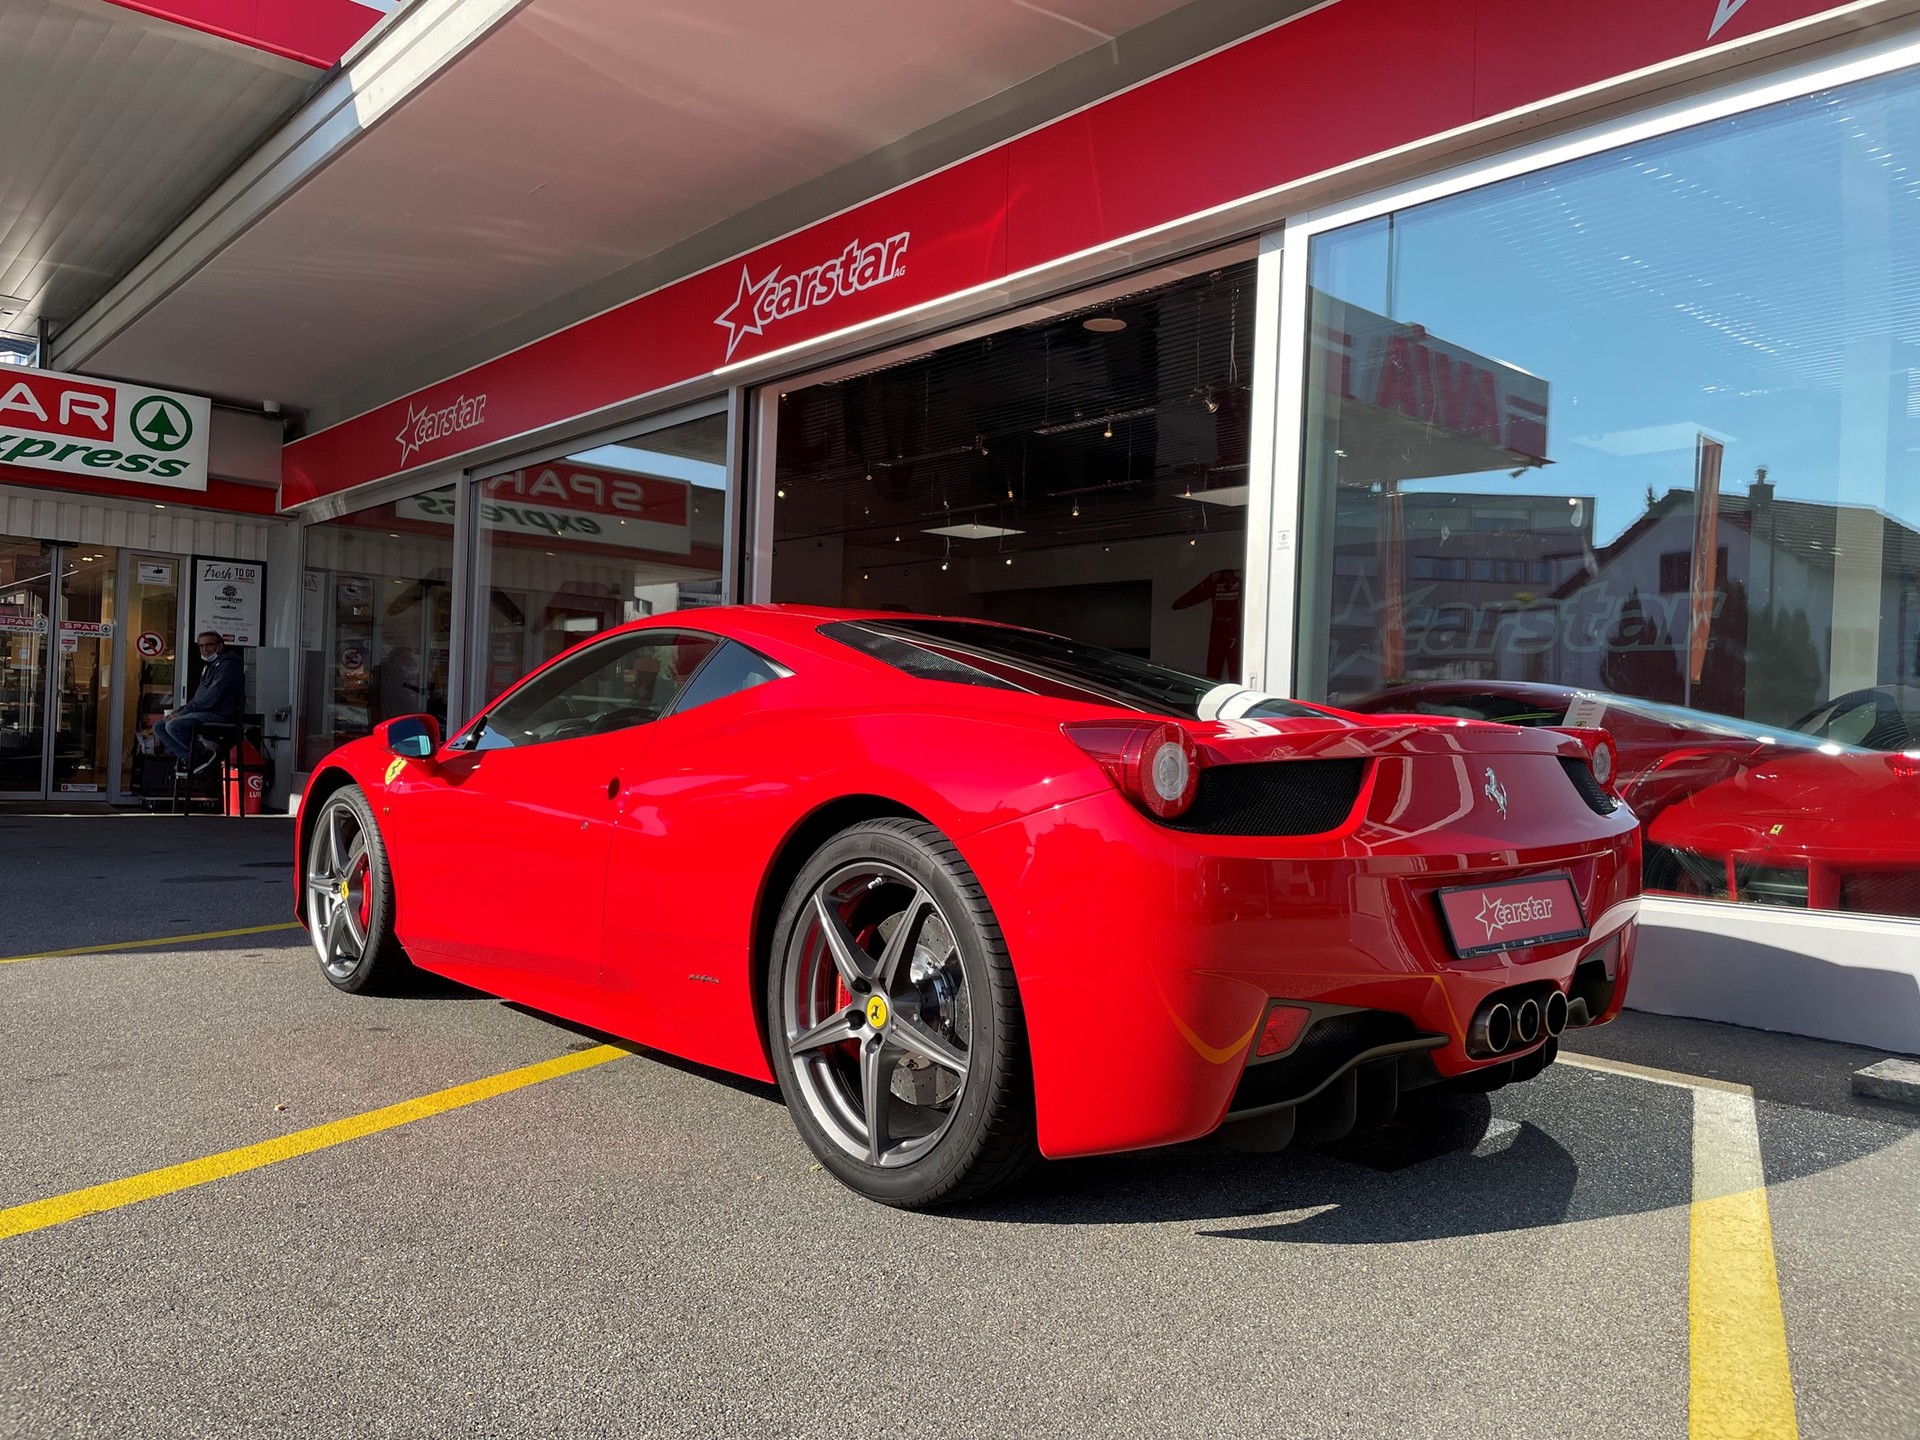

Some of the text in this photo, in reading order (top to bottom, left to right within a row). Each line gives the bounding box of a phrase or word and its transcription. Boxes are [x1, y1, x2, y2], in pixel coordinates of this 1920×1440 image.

[753, 231, 910, 325] carstar AG
[414, 394, 487, 445] carstar
[204, 564, 231, 579] Fresh
[234, 567, 244, 578] TO
[245, 568, 255, 579] GO
[64, 622, 99, 631] SPAR
[1379, 579, 1725, 654] carstar
[1494, 896, 1553, 925] carstar
